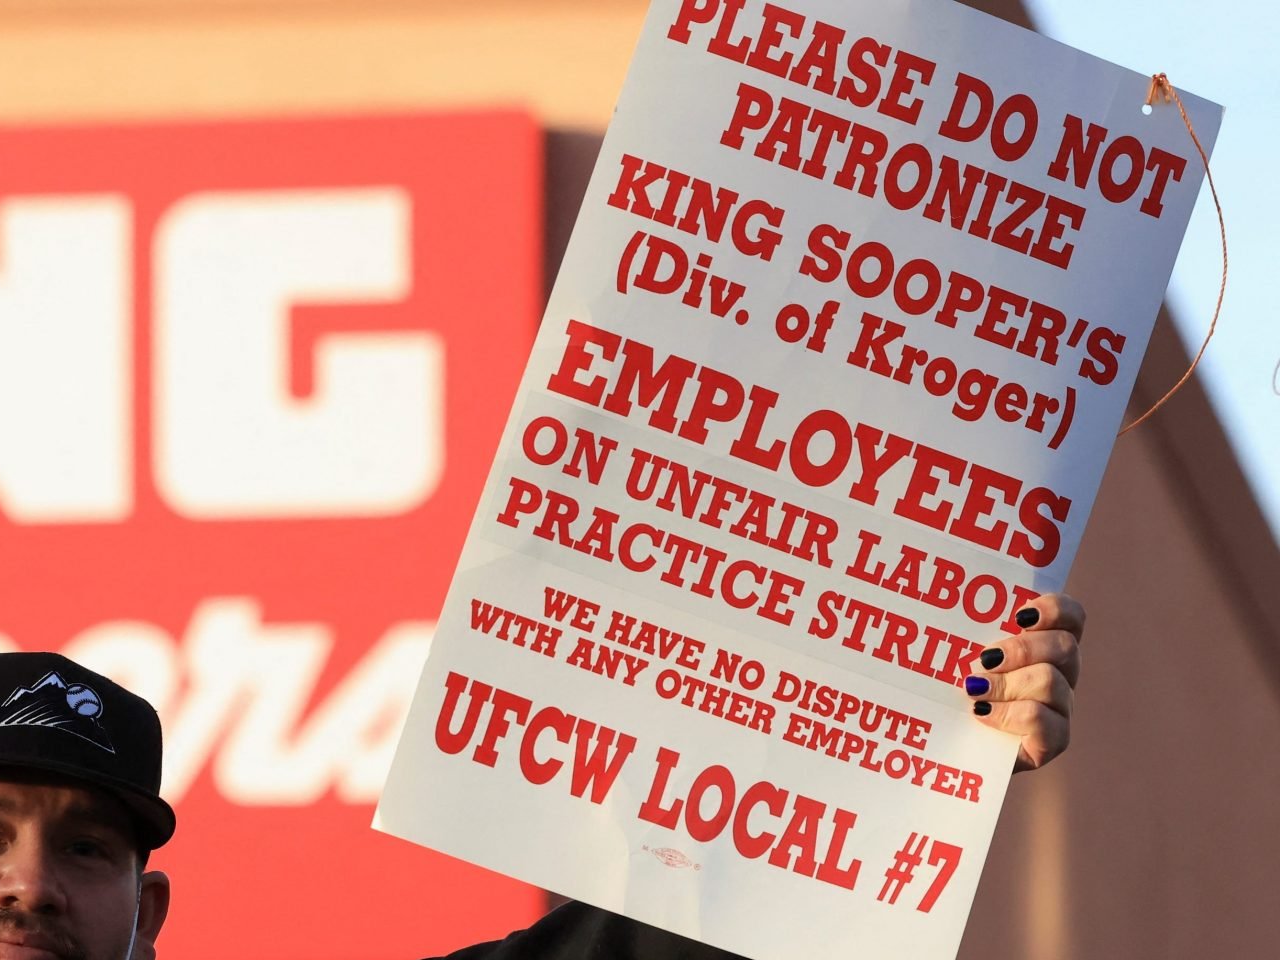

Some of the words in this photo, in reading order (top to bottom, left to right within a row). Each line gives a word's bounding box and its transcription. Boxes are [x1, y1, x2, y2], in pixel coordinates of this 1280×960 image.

[667, 0, 937, 126] PLEASE
[939, 72, 1039, 163] DO
[1047, 113, 1187, 219] NOT
[720, 82, 1087, 271] PATRONIZE
[608, 154, 785, 261] KING
[799, 223, 1126, 387] SOOPER'S
[615, 231, 749, 326] (Div.
[775, 302, 841, 354] of
[848, 312, 1078, 451] Kroger)
[521, 416, 618, 486] ON
[624, 449, 853, 570] UNFAIR
[546, 319, 1073, 569] EMPLOYEES
[496, 476, 805, 627] PRACTICE
[808, 590, 987, 689] STRIK
[542, 585, 600, 632] WE
[609, 609, 707, 672] HAVE
[715, 647, 766, 692] NO
[771, 669, 933, 751] DISPUTE
[433, 671, 637, 805] UFCW
[637, 745, 863, 891] LOCAL
[876, 831, 964, 914] #7
[469, 598, 564, 657] WITH
[566, 635, 649, 687] ANY
[655, 669, 775, 735] OTHER
[788, 715, 985, 804] EMPLOYER
